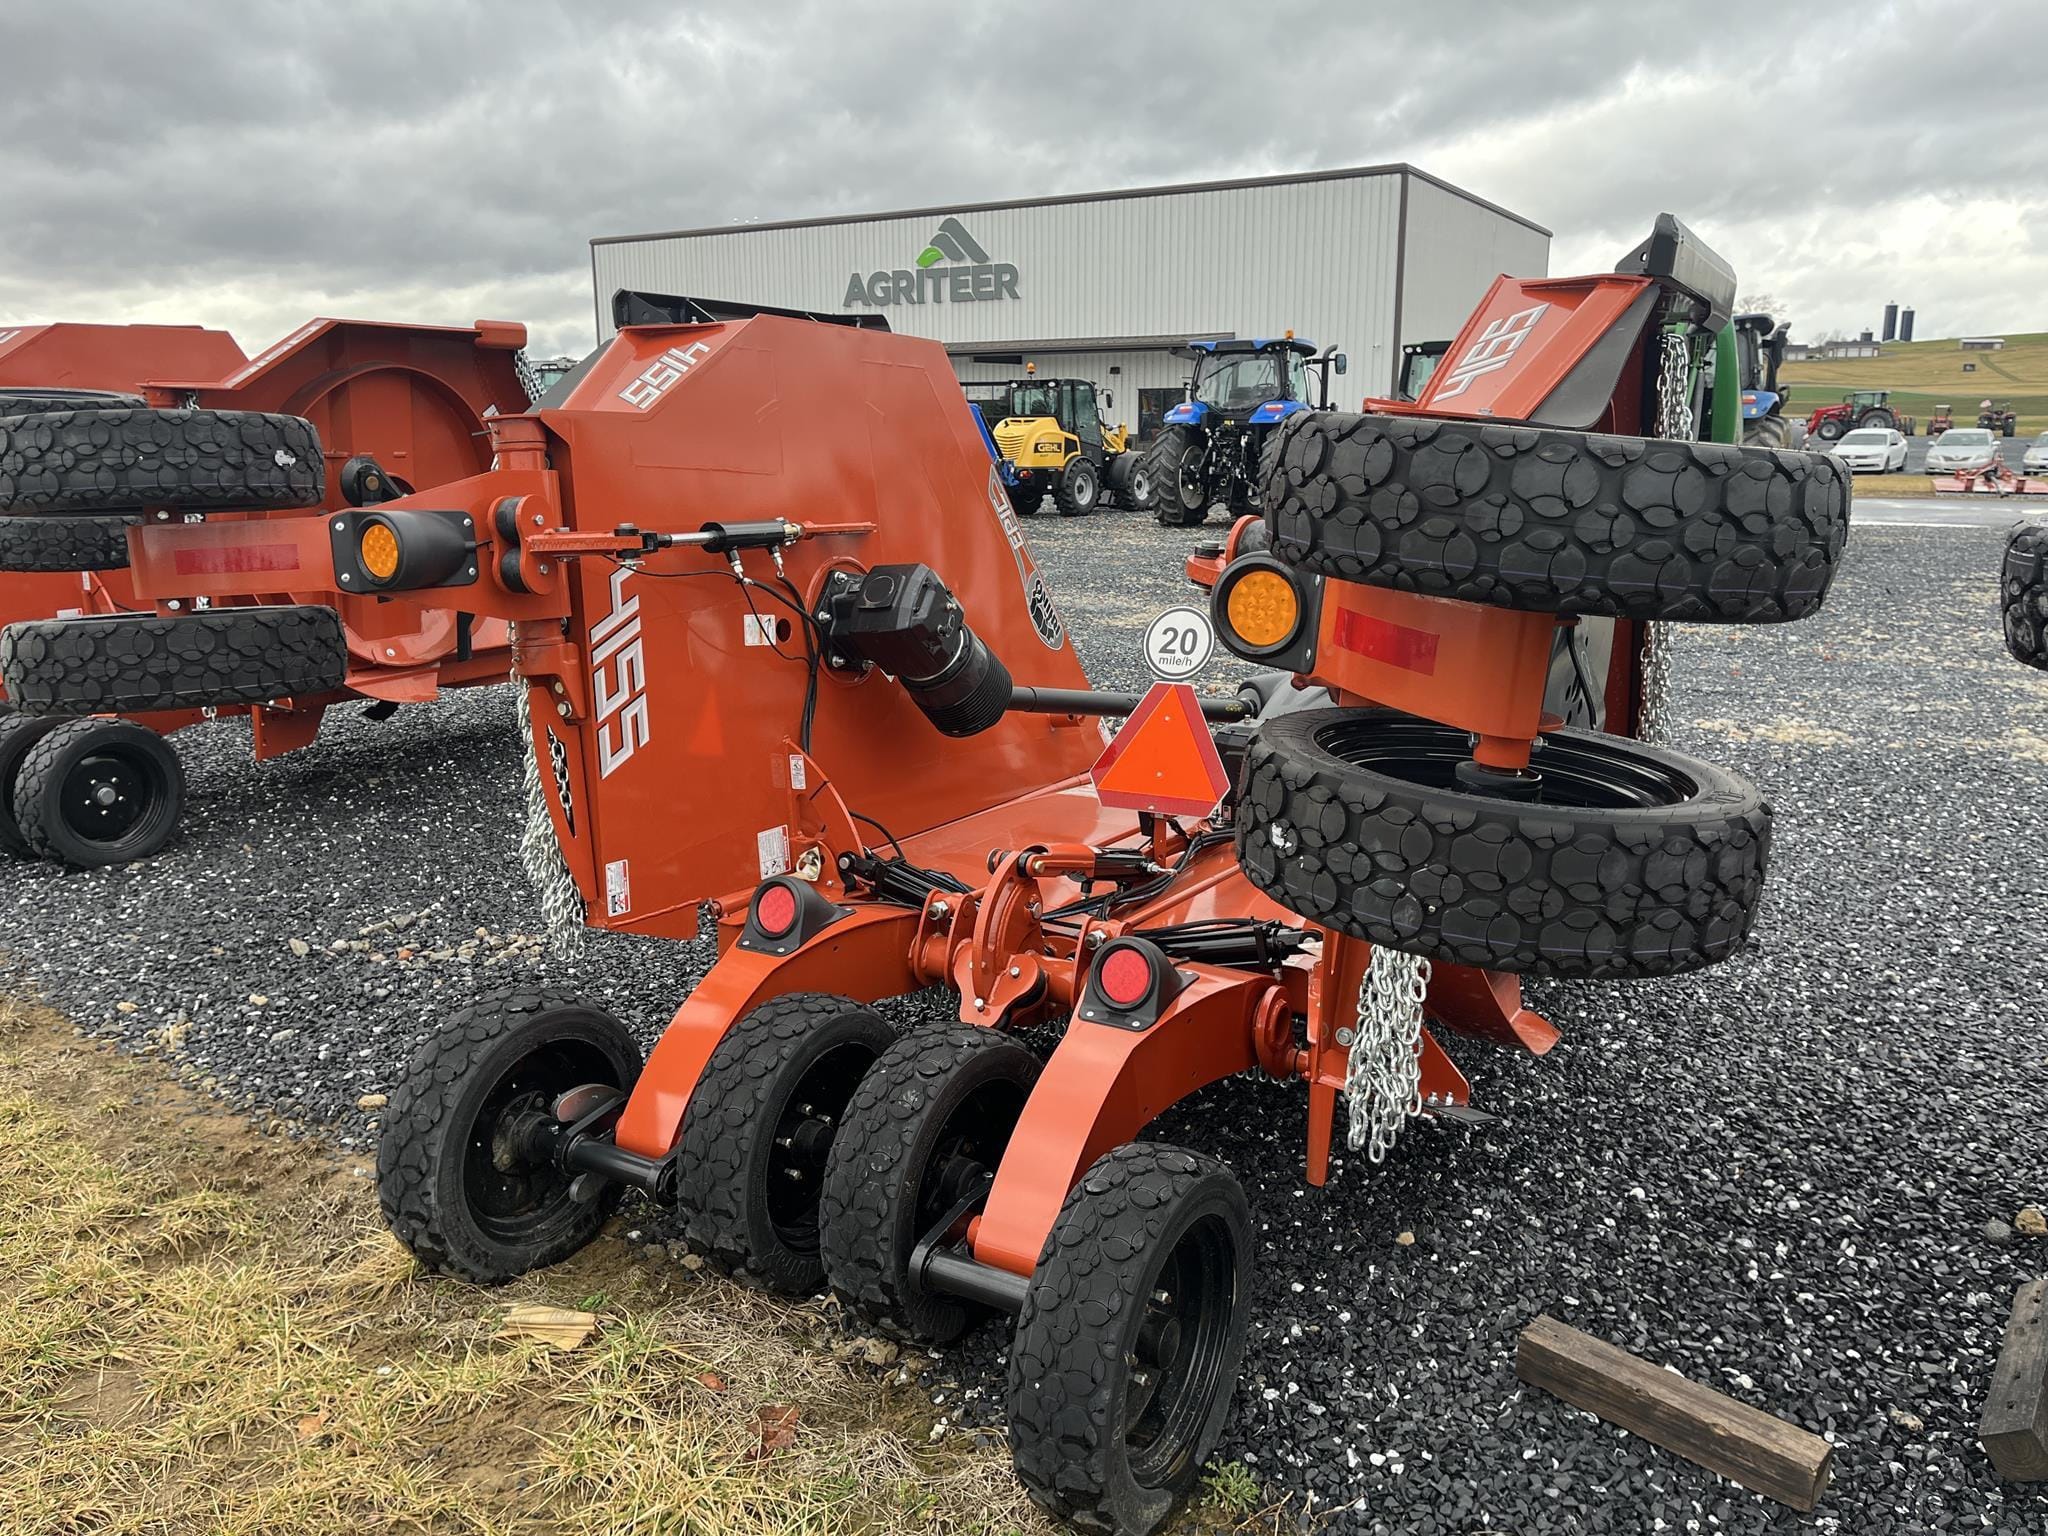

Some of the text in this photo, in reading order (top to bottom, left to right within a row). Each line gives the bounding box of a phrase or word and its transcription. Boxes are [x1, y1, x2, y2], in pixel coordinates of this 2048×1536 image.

[843, 263, 1021, 307] AGRITEER
[617, 341, 710, 409] 4155
[1432, 303, 1551, 402] 4155
[1037, 443, 1061, 452] GEHL
[993, 493, 1025, 550] EPIC
[1158, 626, 1198, 656] 20
[1158, 656, 1192, 667] mile/h
[589, 566, 650, 780] 4155
